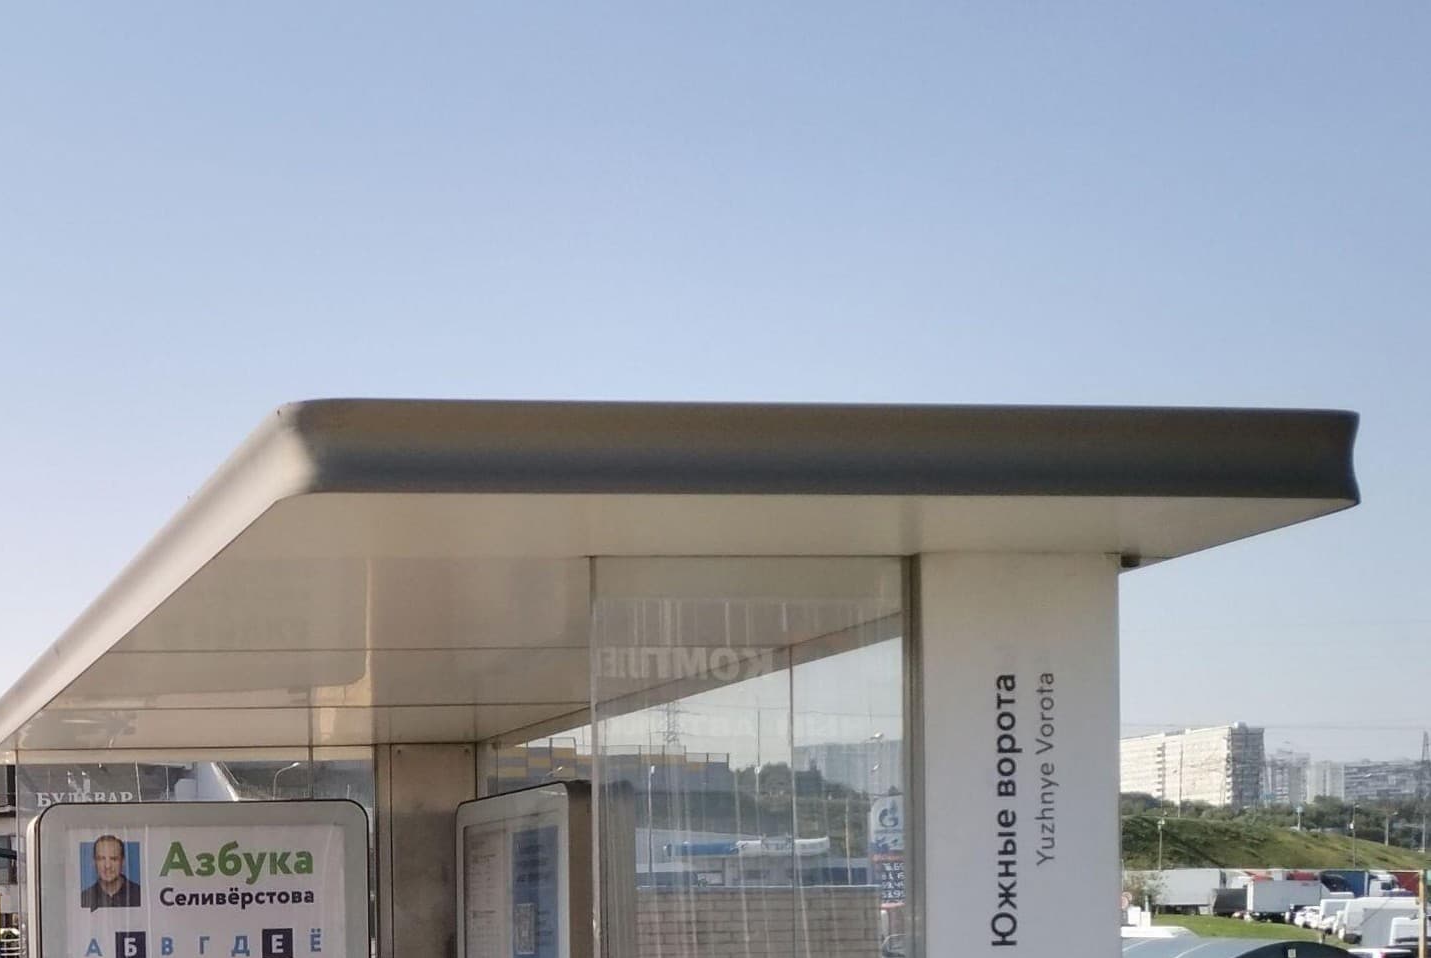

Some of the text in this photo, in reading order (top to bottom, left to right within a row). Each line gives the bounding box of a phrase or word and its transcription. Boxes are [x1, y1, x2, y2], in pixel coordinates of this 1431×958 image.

[1035, 672, 1059, 866] Yuzhnye Vorota
[991, 673, 1022, 947] Южные ворота
[160, 840, 314, 885] Азбука
[159, 887, 315, 909] Селивёрстова
[86, 928, 322, 957] А Б В Г Д Е Ё
